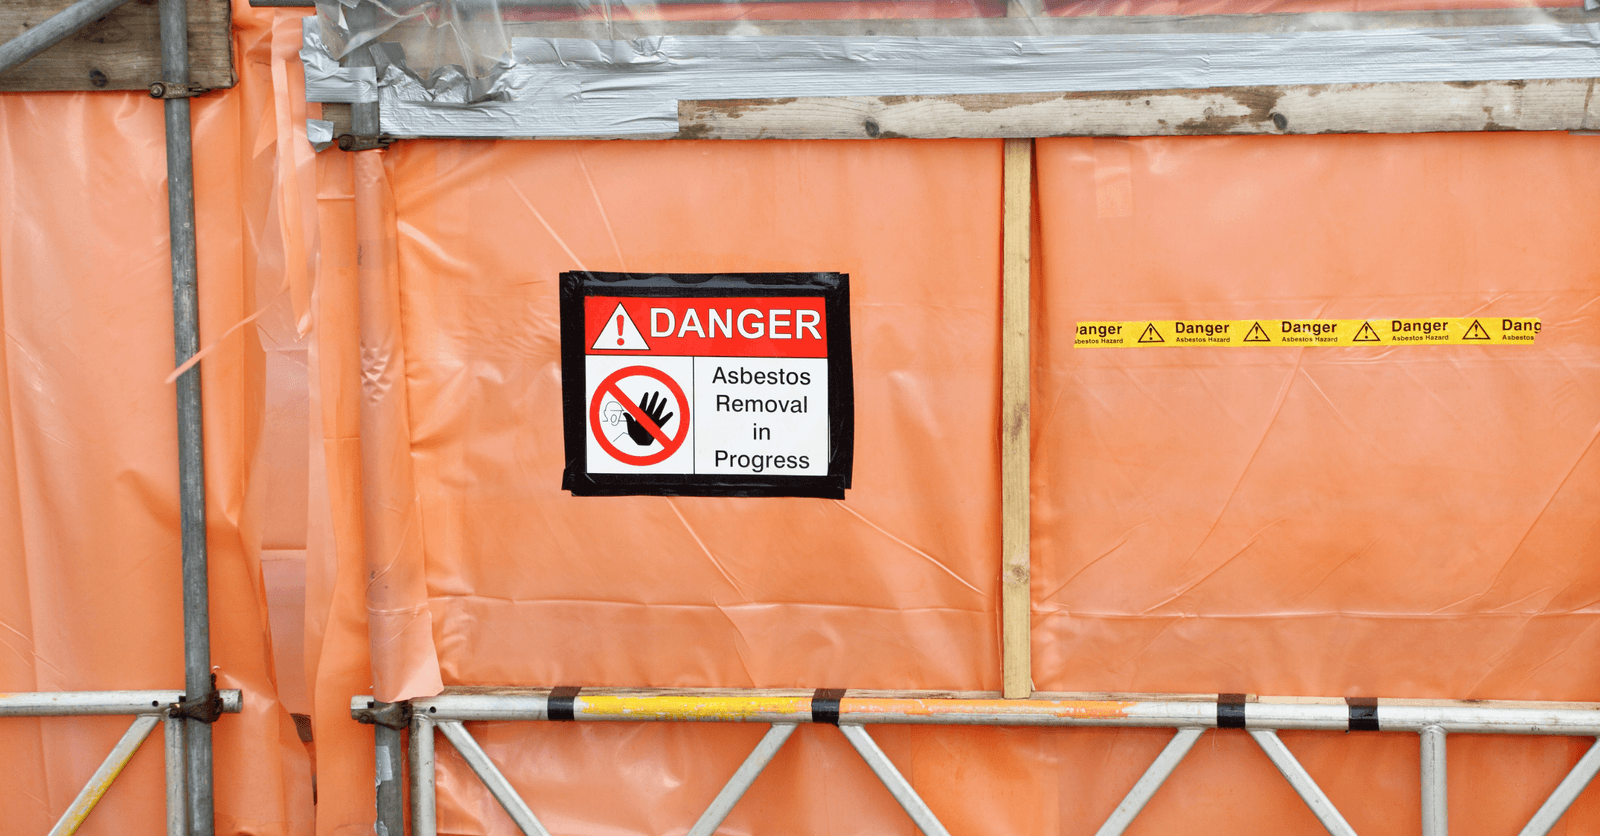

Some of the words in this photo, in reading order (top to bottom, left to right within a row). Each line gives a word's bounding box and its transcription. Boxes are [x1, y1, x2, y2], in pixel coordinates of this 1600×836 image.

[650, 307, 822, 340] DANGER
[1076, 325, 1123, 338] anger
[1175, 321, 1230, 337] Danger
[1281, 320, 1338, 336] Danger
[1391, 319, 1449, 334] Danger
[1502, 318, 1542, 334] Dang
[712, 366, 811, 386] Asbestos
[716, 394, 808, 414] Removal
[753, 422, 771, 441] in
[714, 450, 810, 473] Progress
